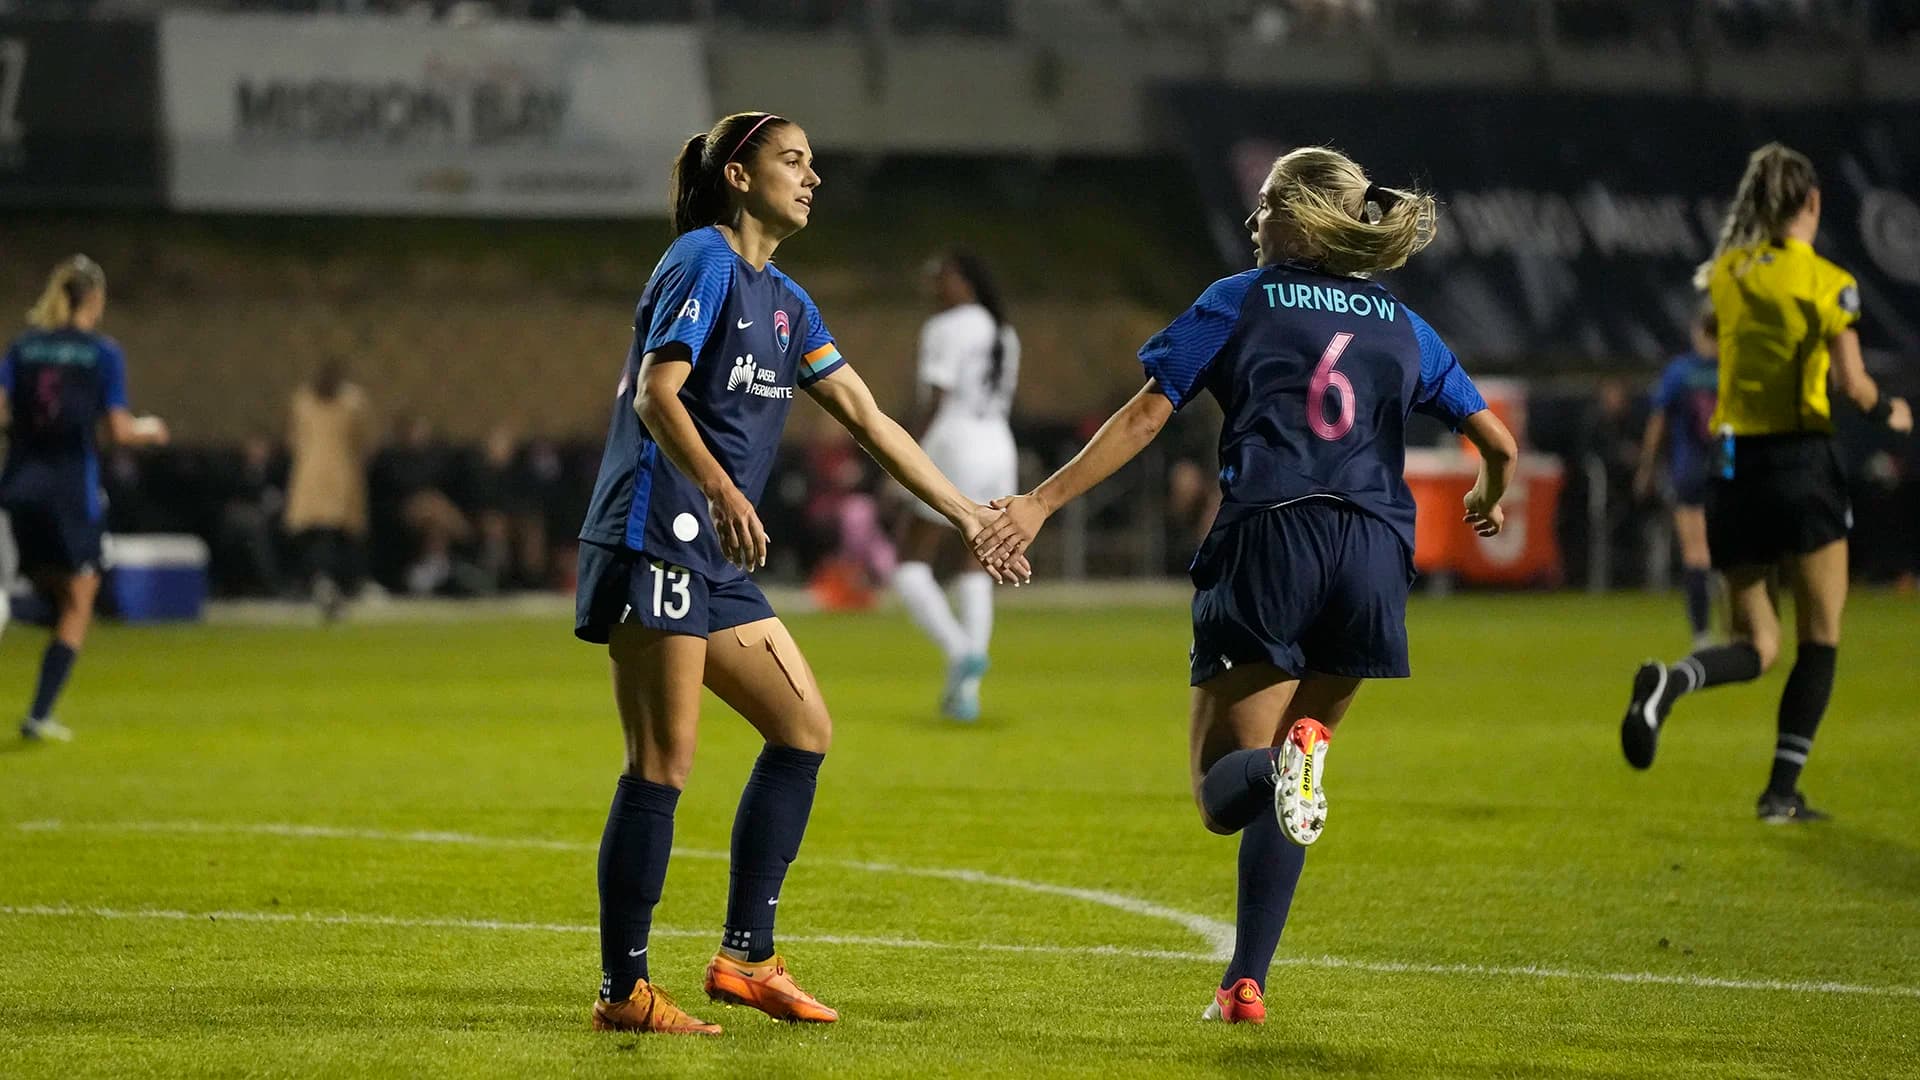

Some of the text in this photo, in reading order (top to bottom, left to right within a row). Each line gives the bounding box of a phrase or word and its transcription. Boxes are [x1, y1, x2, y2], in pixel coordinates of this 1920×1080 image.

[1263, 283, 1395, 322] TURNBOW
[1305, 331, 1356, 441] 6
[649, 560, 691, 619] 13
[1302, 754, 1313, 791] TIEMPO
